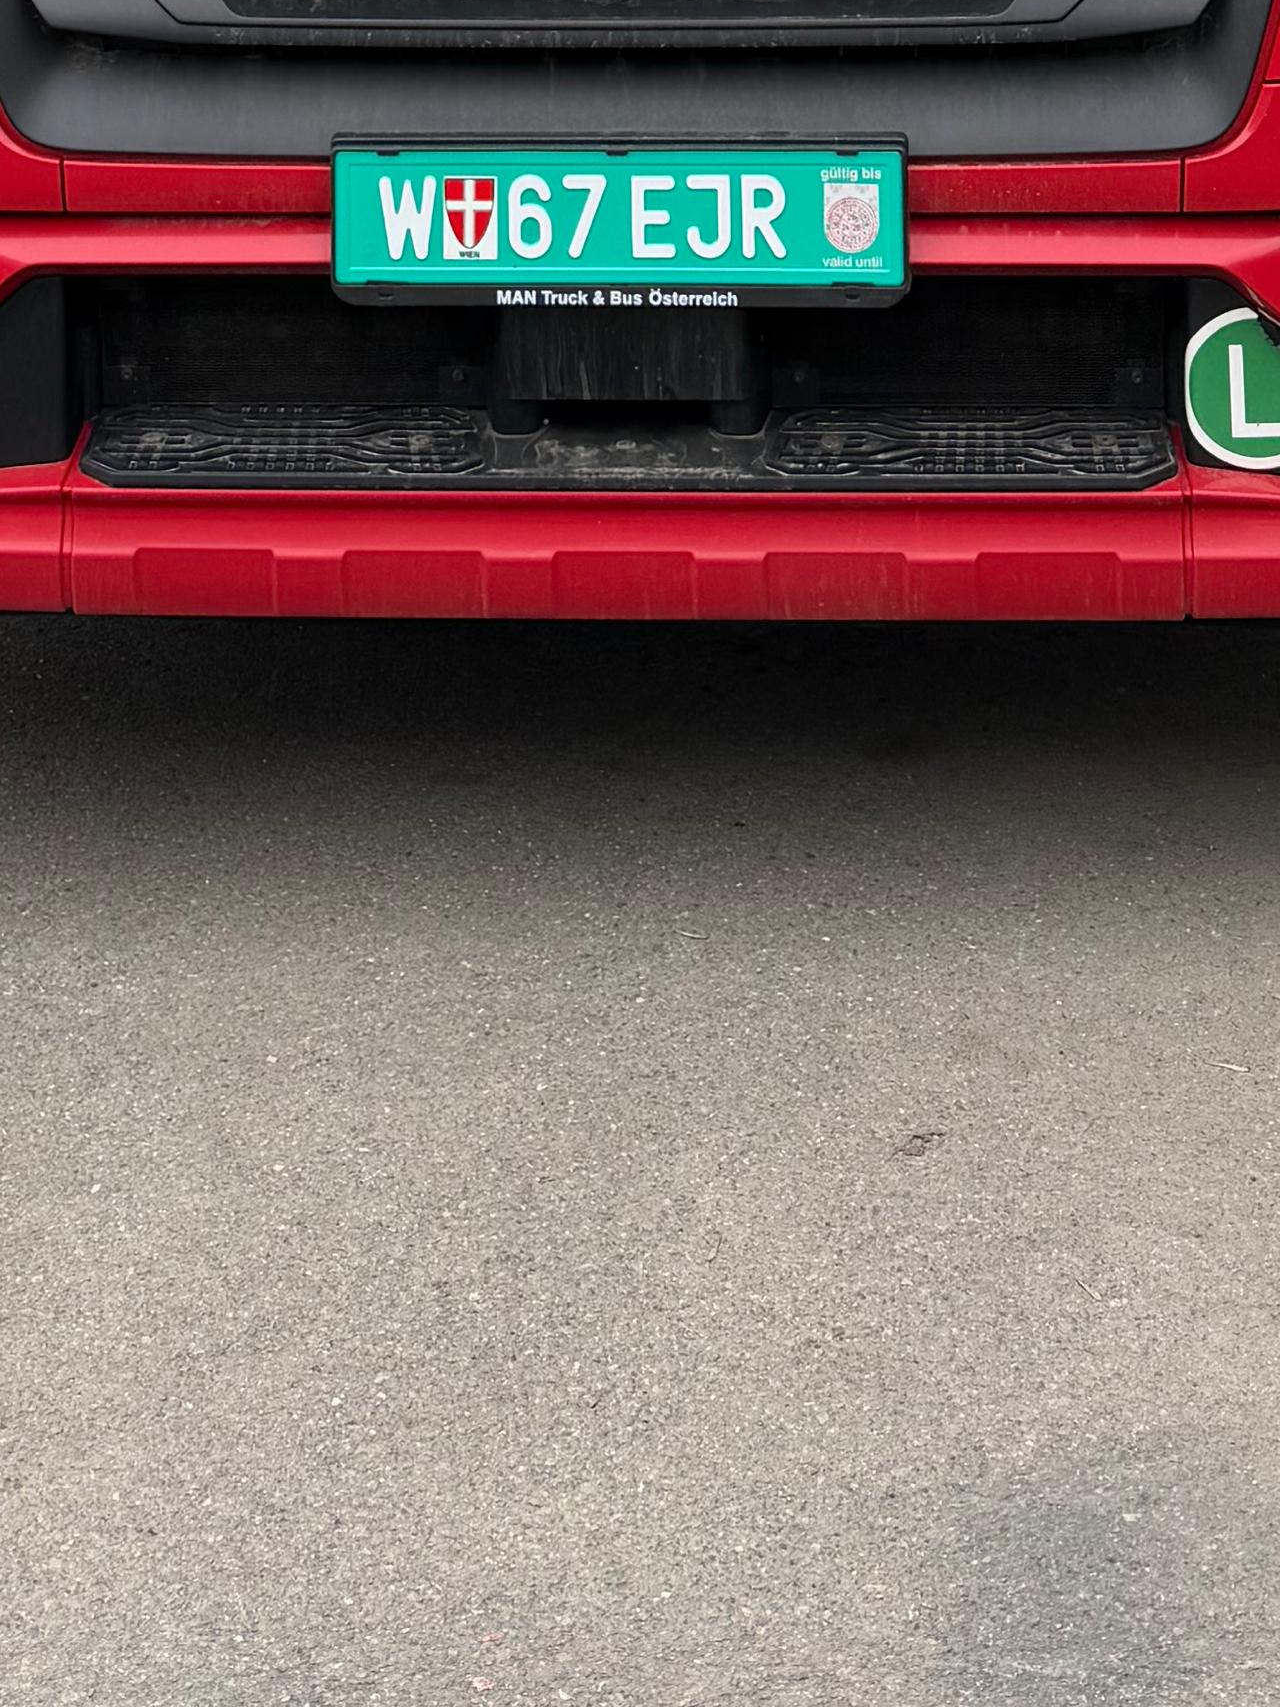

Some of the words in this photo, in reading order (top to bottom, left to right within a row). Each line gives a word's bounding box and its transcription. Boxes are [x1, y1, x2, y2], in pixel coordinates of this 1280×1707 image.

[820, 167, 858, 181] gültig
[862, 168, 881, 180] bis
[378, 175, 436, 261] W
[508, 173, 607, 260] 67
[631, 174, 787, 260] EJR
[822, 255, 852, 268] valid
[855, 256, 883, 268] until
[496, 290, 536, 306] MAN
[540, 290, 589, 306] Truck
[593, 290, 606, 306] &
[610, 290, 642, 306] Bus
[648, 287, 738, 306] Österreich
